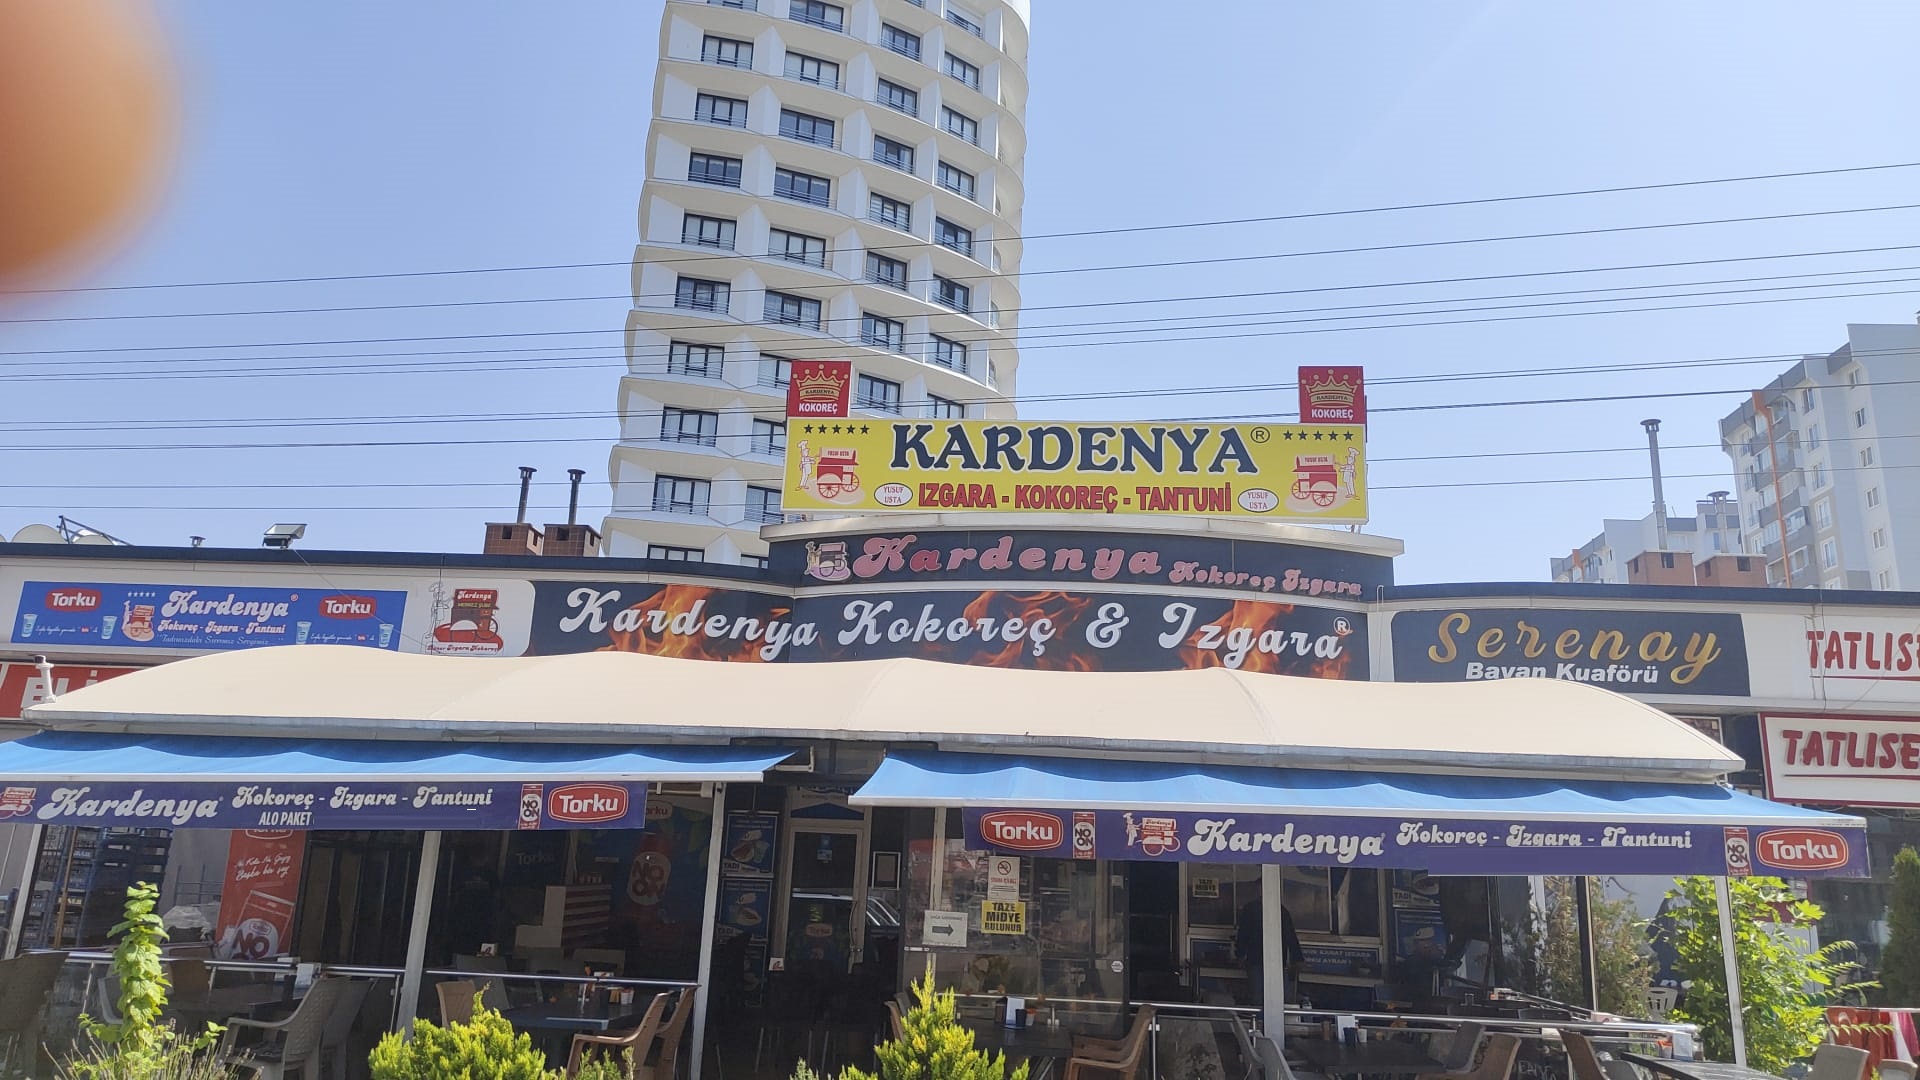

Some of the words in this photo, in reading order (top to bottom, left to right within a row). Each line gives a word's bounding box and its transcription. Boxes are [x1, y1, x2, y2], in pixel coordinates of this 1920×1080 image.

[798, 402, 838, 414] KOKOREÇ
[1311, 408, 1354, 419] KOKOREÇ
[890, 423, 1259, 474] KARDENYA
[883, 486, 904, 494] YUSUF
[918, 483, 997, 508] IZGARA
[1015, 484, 1118, 513] KOKOREÇ
[1136, 482, 1232, 512] TANTUNİ
[1247, 491, 1269, 499] YUSUF
[884, 496, 902, 504] USTA
[1249, 502, 1268, 510] USTA
[852, 534, 1162, 581] Kardenya
[1168, 561, 1276, 592] Kokoreç
[51, 592, 97, 607] Torku
[457, 590, 492, 601] Kardenya
[161, 590, 289, 623] Kardenya
[325, 600, 371, 614] Torku
[157, 619, 199, 634] Kokoreç
[245, 621, 286, 635] Tantuni
[559, 587, 819, 662] Kardenya
[837, 600, 1056, 657] Kokoreç
[1085, 602, 1130, 649] &
[1158, 602, 1343, 669] Izgara
[1428, 612, 1722, 684] Serenay
[1465, 662, 1546, 680] Bayan
[1555, 662, 1658, 684] Kuaförü
[37, 786, 219, 825] Kardenya
[231, 785, 315, 810] Kokoreç
[329, 785, 397, 811] Izgara
[413, 785, 493, 809] Tantuni
[522, 800, 538, 809] NO
[558, 793, 619, 814] Torku
[258, 811, 278, 826] ALO
[280, 811, 312, 827] PAKET
[991, 820, 1053, 841] Torku
[1074, 828, 1092, 838] NO
[1076, 837, 1094, 847] ON
[1187, 818, 1385, 864] Kardenya
[1396, 822, 1488, 847] Kokoreç
[1505, 824, 1582, 847] Izgara
[1600, 826, 1693, 849] Tantuni
[1727, 844, 1745, 854] NO
[1768, 838, 1839, 860] Torku
[992, 902, 1016, 912] TAZE
[984, 922, 1021, 932] BULUNUR
